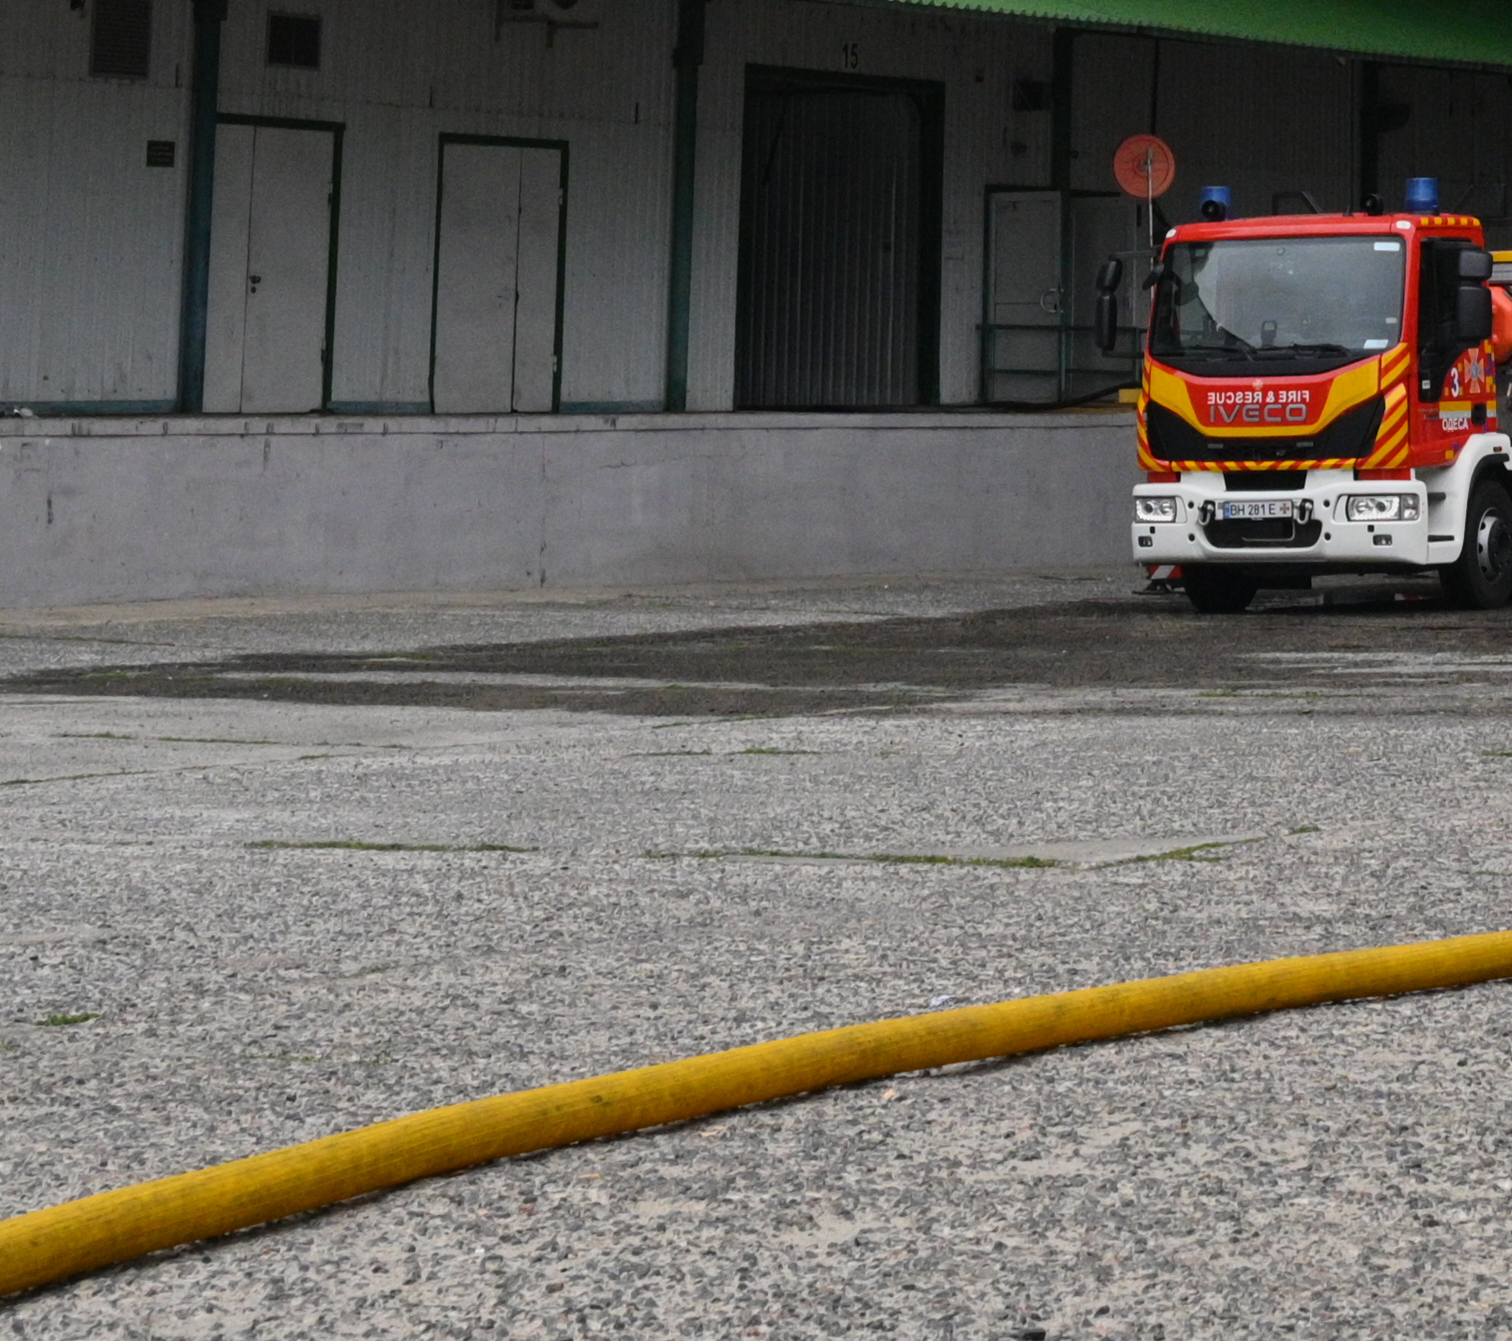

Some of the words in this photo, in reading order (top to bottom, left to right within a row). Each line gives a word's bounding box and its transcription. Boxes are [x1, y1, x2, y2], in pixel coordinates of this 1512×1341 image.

[842, 42, 858, 69] 15
[1451, 367, 1460, 397] 3
[1210, 403, 1307, 423] IVECO
[1442, 417, 1469, 432] ОДЕСА
[1230, 504, 1245, 516] BH
[1248, 503, 1266, 516] 281
[1269, 504, 1276, 515] E
